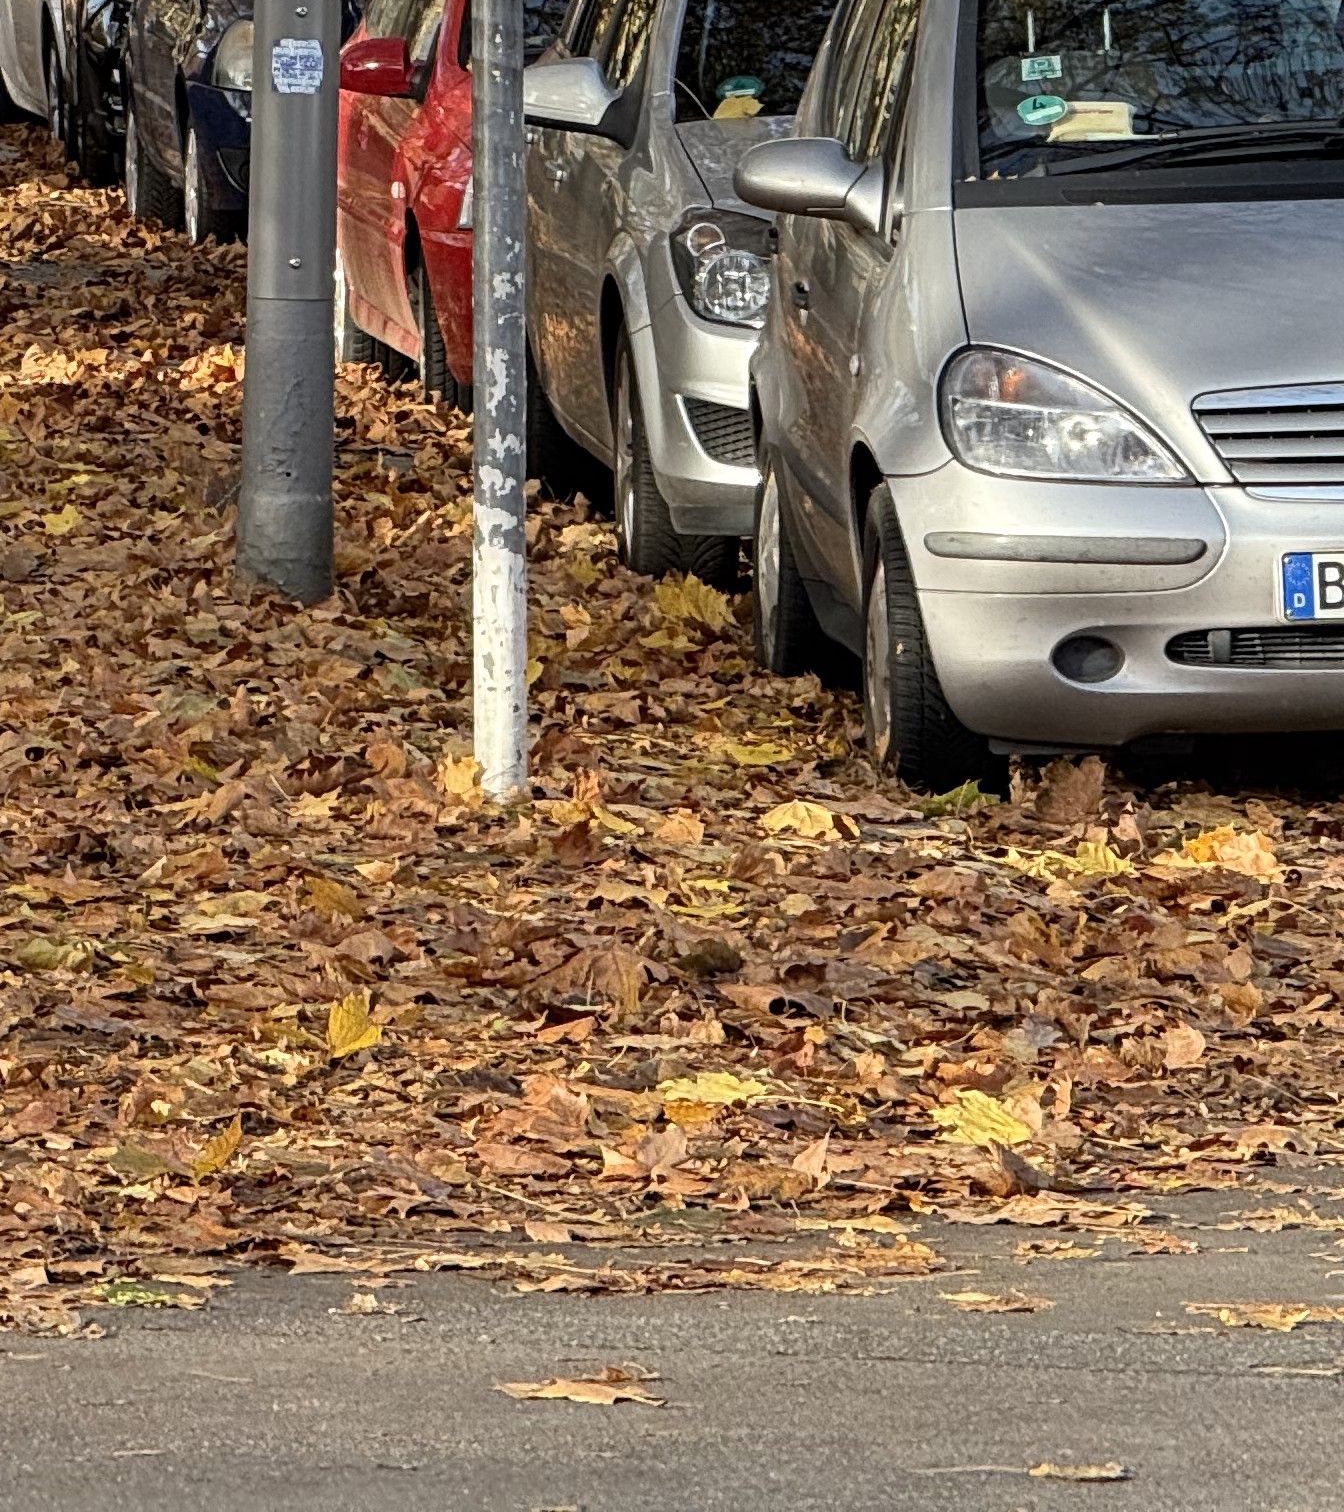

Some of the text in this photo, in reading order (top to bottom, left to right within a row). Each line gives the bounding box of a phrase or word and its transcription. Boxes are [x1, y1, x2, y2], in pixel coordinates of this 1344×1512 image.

[1032, 98, 1047, 110] 4
[1317, 561, 1344, 610] B
[1293, 592, 1306, 608] D
